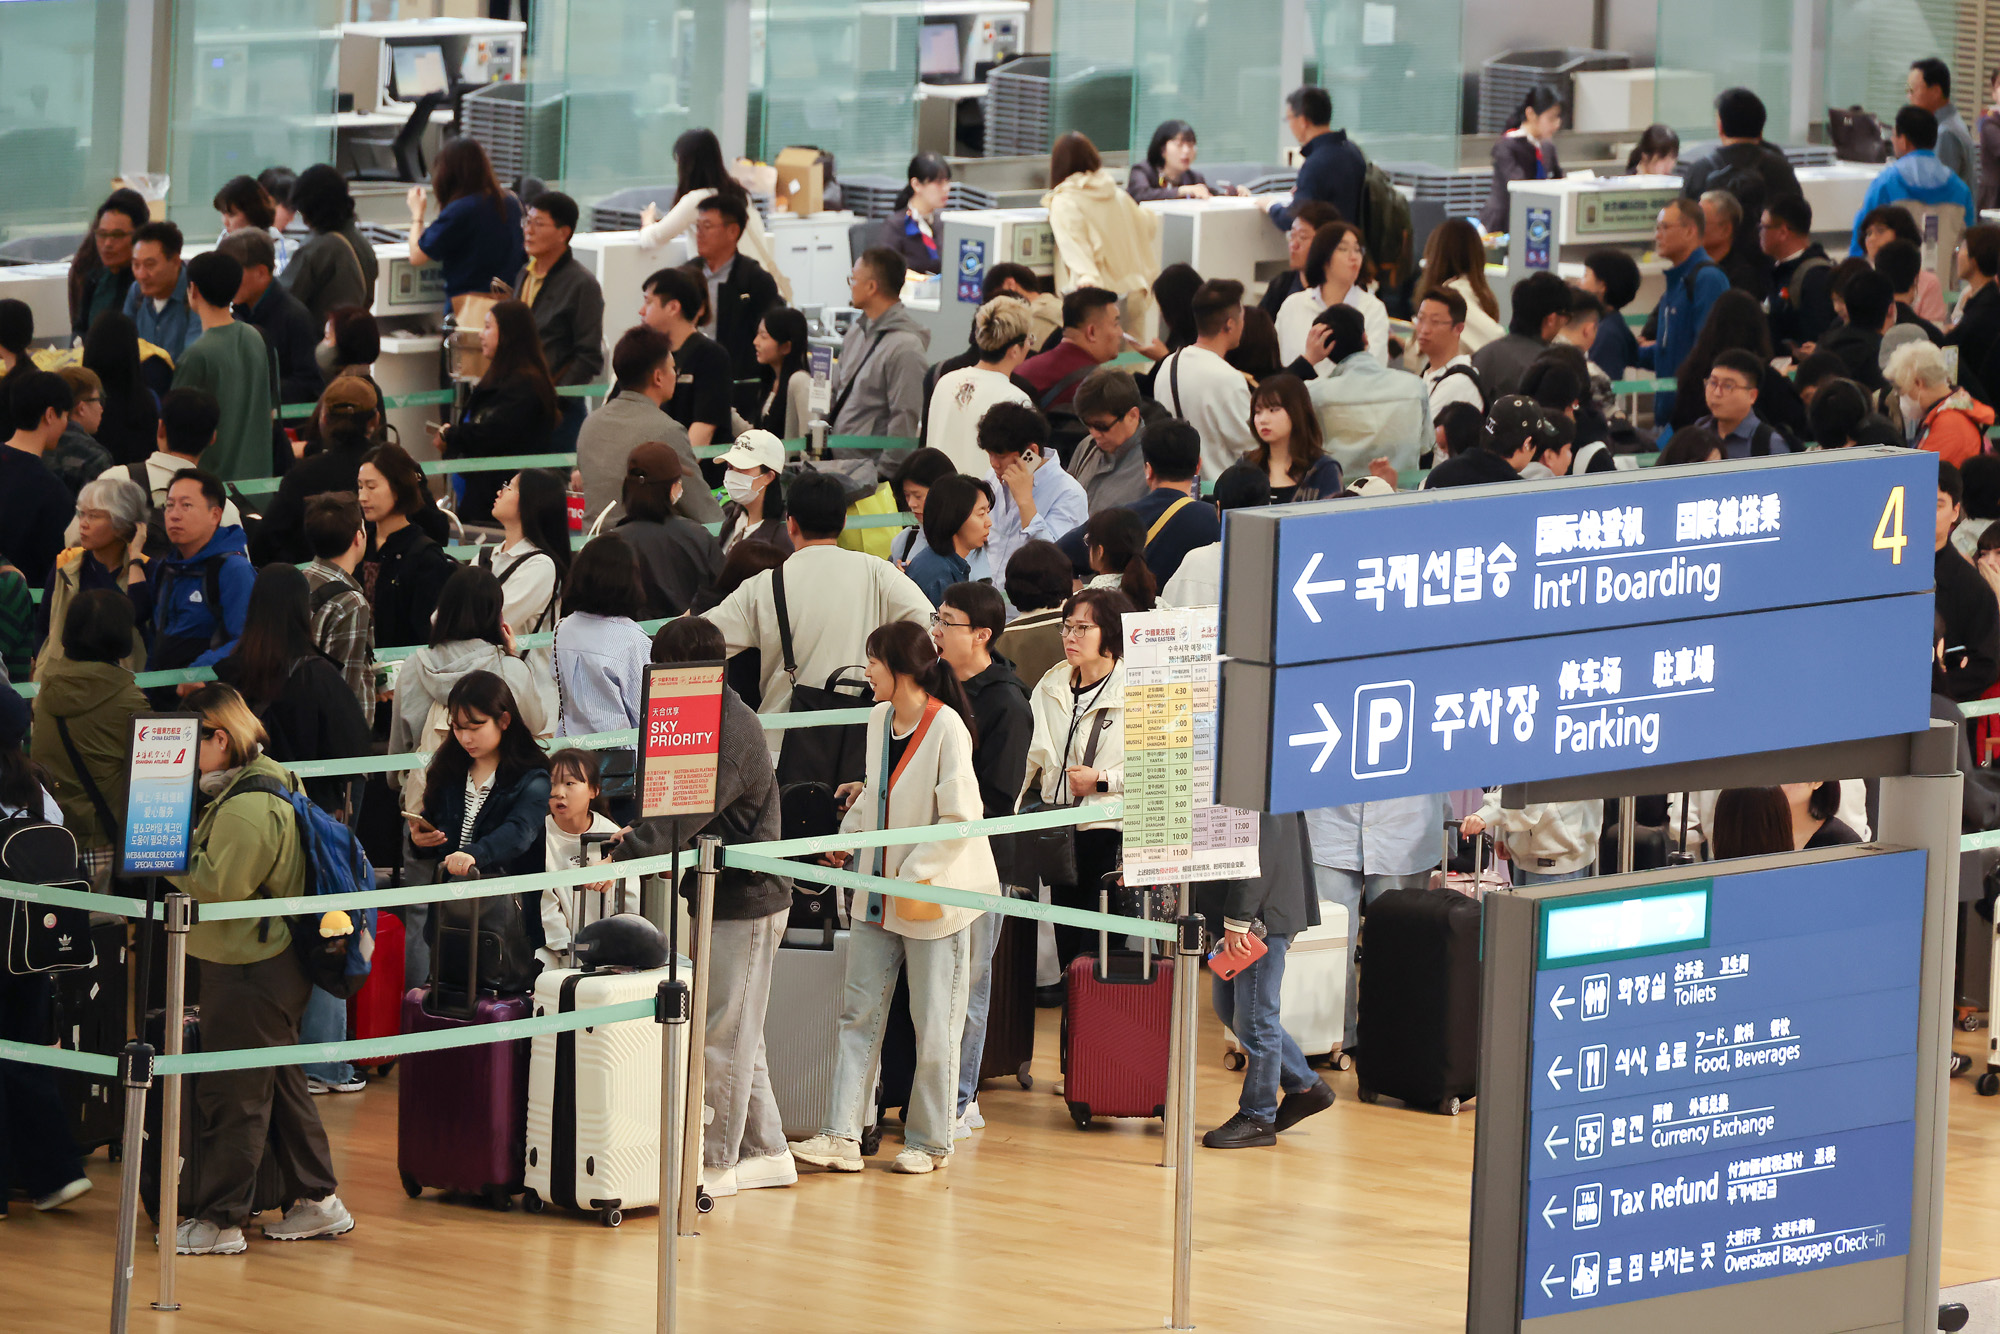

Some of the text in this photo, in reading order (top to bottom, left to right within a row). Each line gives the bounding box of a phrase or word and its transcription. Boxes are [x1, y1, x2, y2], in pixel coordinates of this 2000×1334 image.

[1872, 485, 1908, 565] 4
[1354, 541, 1518, 612] 국제선탑승
[1595, 556, 1721, 604] Boarding
[1168, 643, 1212, 653] 수속시작 예정시간
[1557, 644, 1715, 701] 停车场 駐車場
[652, 707, 679, 716] 天合优享
[1431, 684, 1540, 751] 주차장
[650, 732, 713, 747] PRIORITY
[651, 720, 678, 734] SKY
[1367, 697, 1404, 766] P
[1554, 706, 1660, 755] Parking
[586, 736, 628, 747] Incheon Airport
[1175, 768, 1187, 776] 9:00
[131, 835, 182, 845] 도움이 필요한 승객
[164, 823, 182, 833] 체크인
[973, 822, 1014, 834] Incheon Airport
[1235, 836, 1249, 844] 17:00
[824, 839, 867, 850] Incheon Airport
[630, 863, 653, 872] Incheon
[16, 890, 38, 899] Airport
[1718, 953, 1750, 975] 卫生间
[1617, 971, 1666, 1006] 화장실
[1673, 983, 1717, 1007] Toilets
[1614, 1041, 1688, 1077] 식사, 음료
[1694, 1044, 1801, 1075] Food, Beverages
[1610, 1114, 1644, 1147] 환전
[1651, 1115, 1775, 1148] Currency Exchange
[1581, 1190, 1596, 1204] TAX
[1610, 1171, 1719, 1217] Tax Refund
[1726, 1178, 1778, 1206] 부가세환급
[1607, 1241, 1716, 1286] 큰 짐 부치는 곳
[1724, 1231, 1886, 1274] Oversized Baggage Check-in
